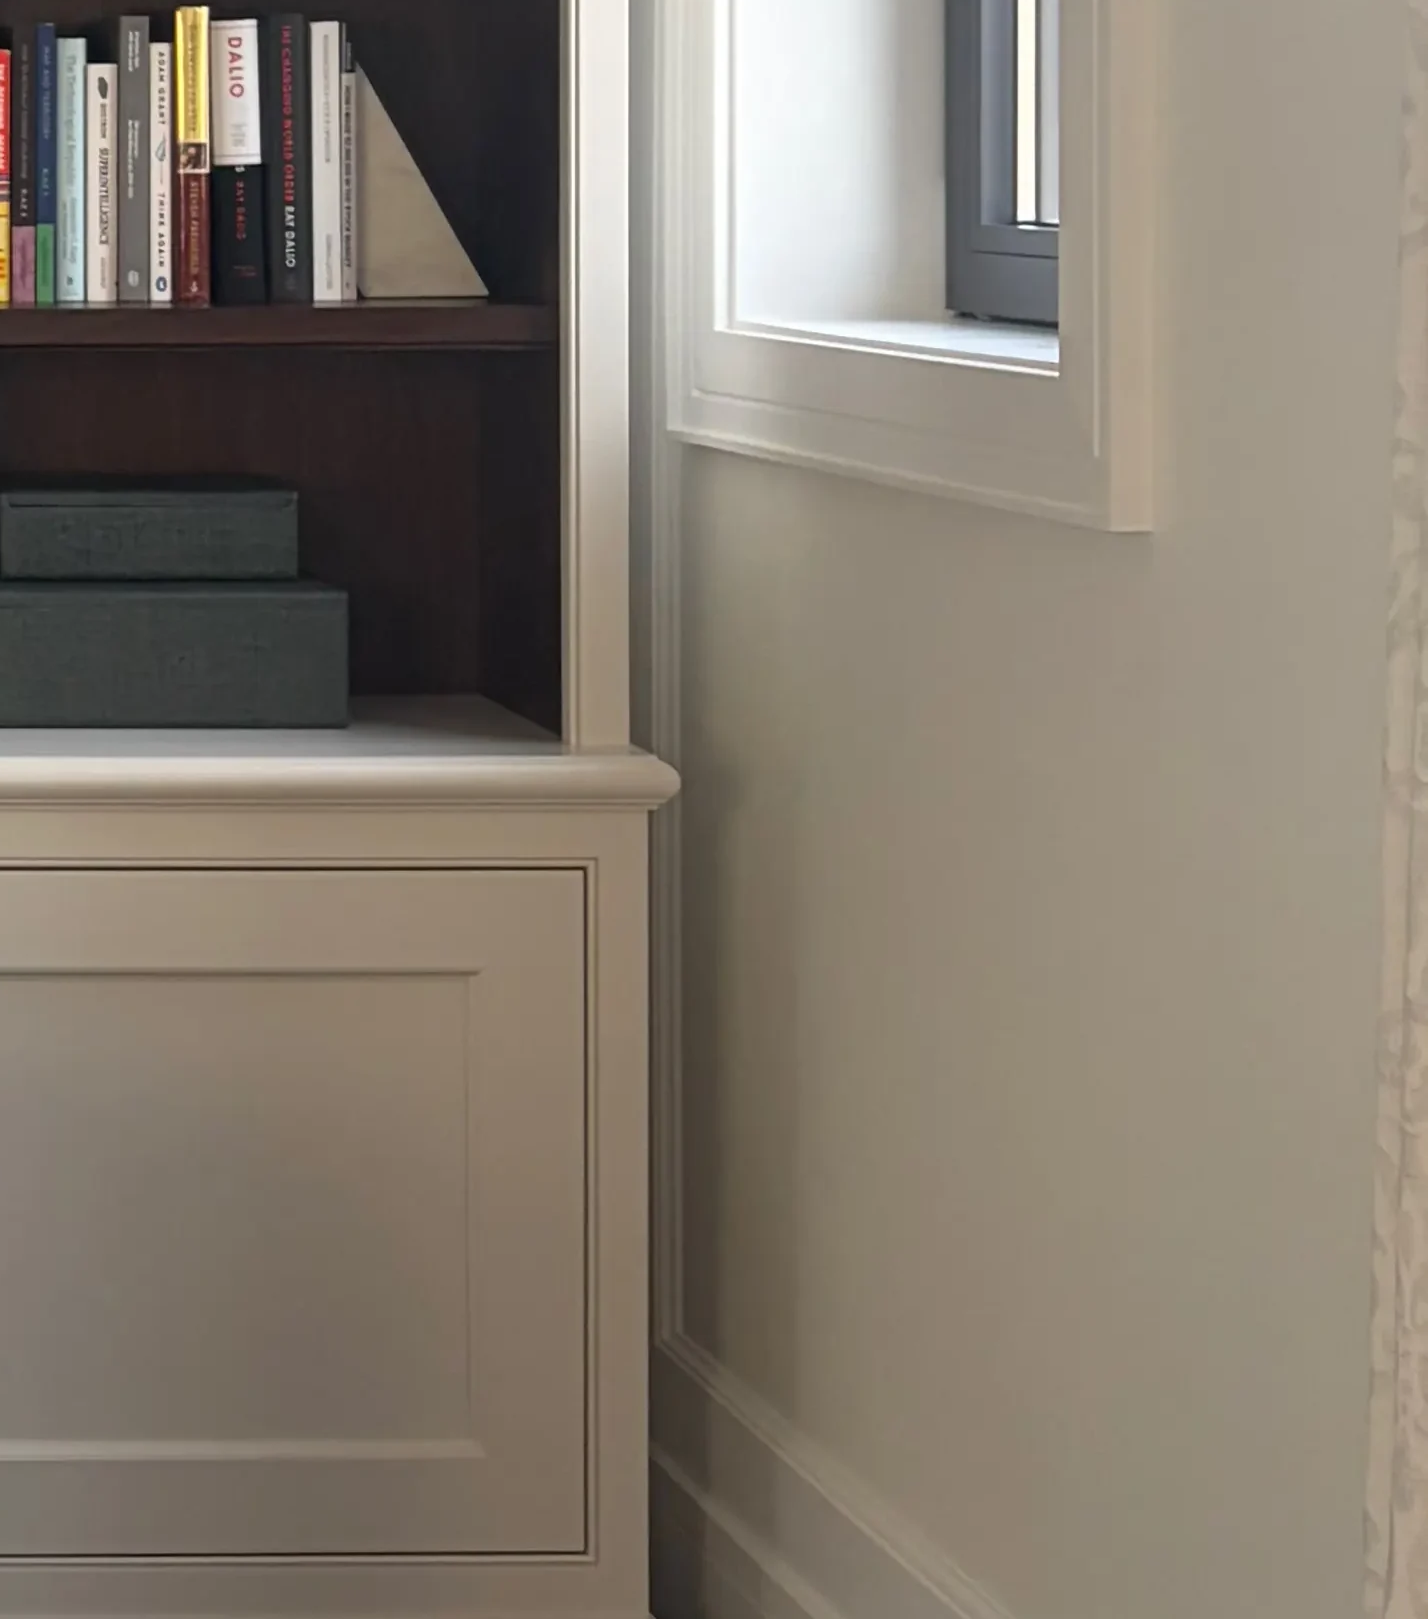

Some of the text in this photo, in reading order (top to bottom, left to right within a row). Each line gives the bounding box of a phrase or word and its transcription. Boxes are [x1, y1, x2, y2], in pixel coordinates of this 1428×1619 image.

[157, 51, 166, 125] ADAM GRANT
[228, 36, 244, 98] DALIO
[283, 120, 293, 159] WORLD
[98, 147, 109, 245] SUPERINTELLIGENCE
[284, 164, 294, 202] ORDER
[157, 192, 166, 268] THINK AGAIN
[285, 205, 295, 226] RAY
[285, 231, 296, 268] DALIO
